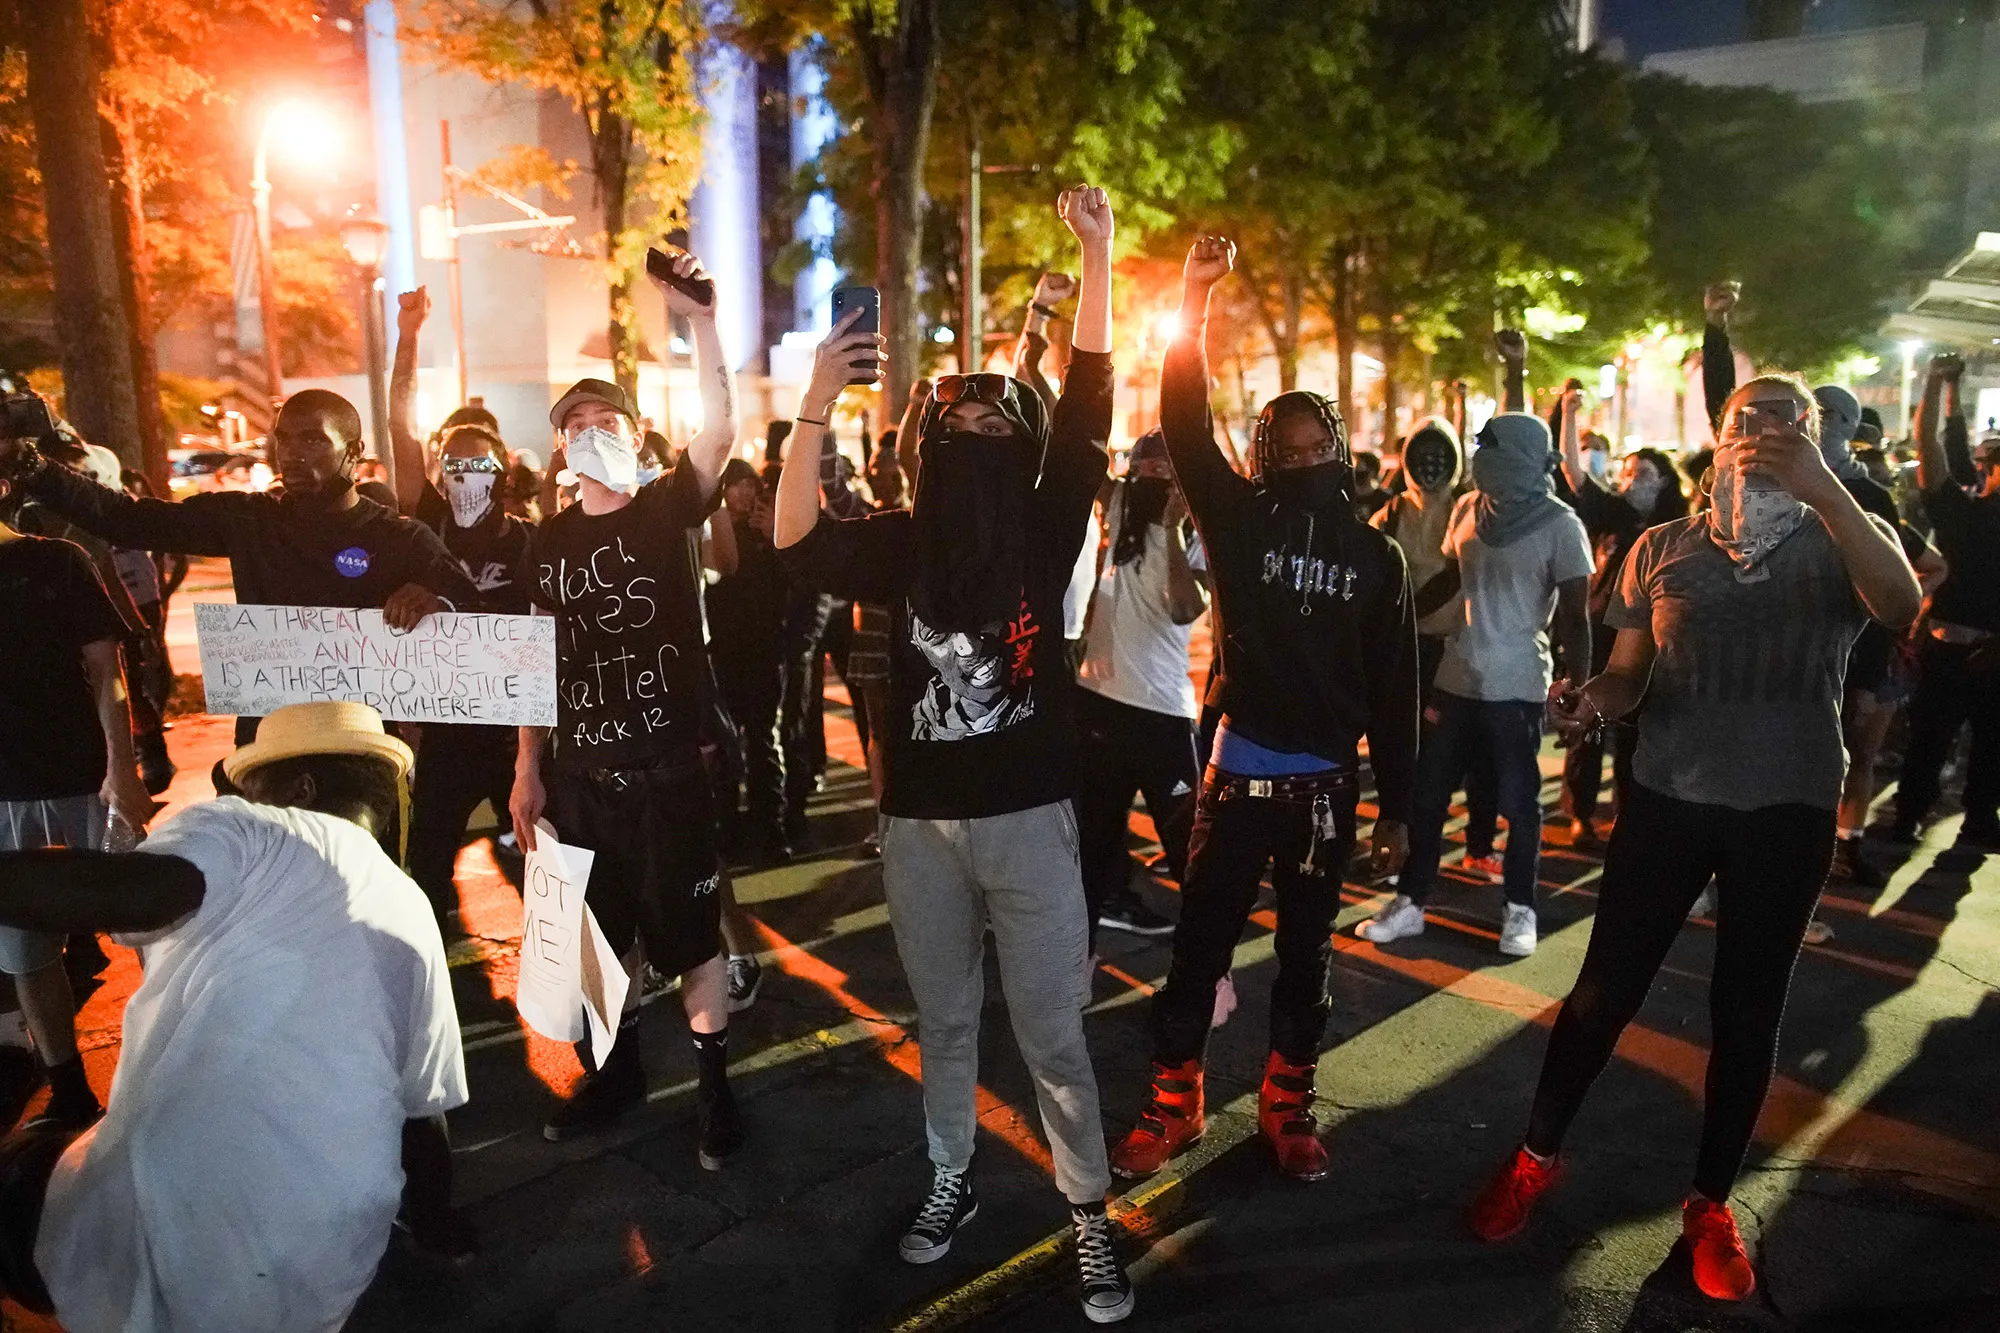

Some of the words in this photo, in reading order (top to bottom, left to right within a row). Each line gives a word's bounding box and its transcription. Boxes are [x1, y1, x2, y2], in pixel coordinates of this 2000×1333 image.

[337, 554, 368, 569] NASA
[232, 608, 258, 631] A
[265, 607, 366, 636] THREAT
[426, 611, 522, 642] JUSTICE
[313, 635, 470, 669] ANYWHERE
[221, 661, 242, 688] IS
[254, 668, 275, 690] A
[273, 665, 371, 694] THREAT
[378, 668, 416, 695] TO
[421, 670, 520, 700] JUSTICE
[642, 707, 670, 733] 12
[526, 857, 571, 912] OT
